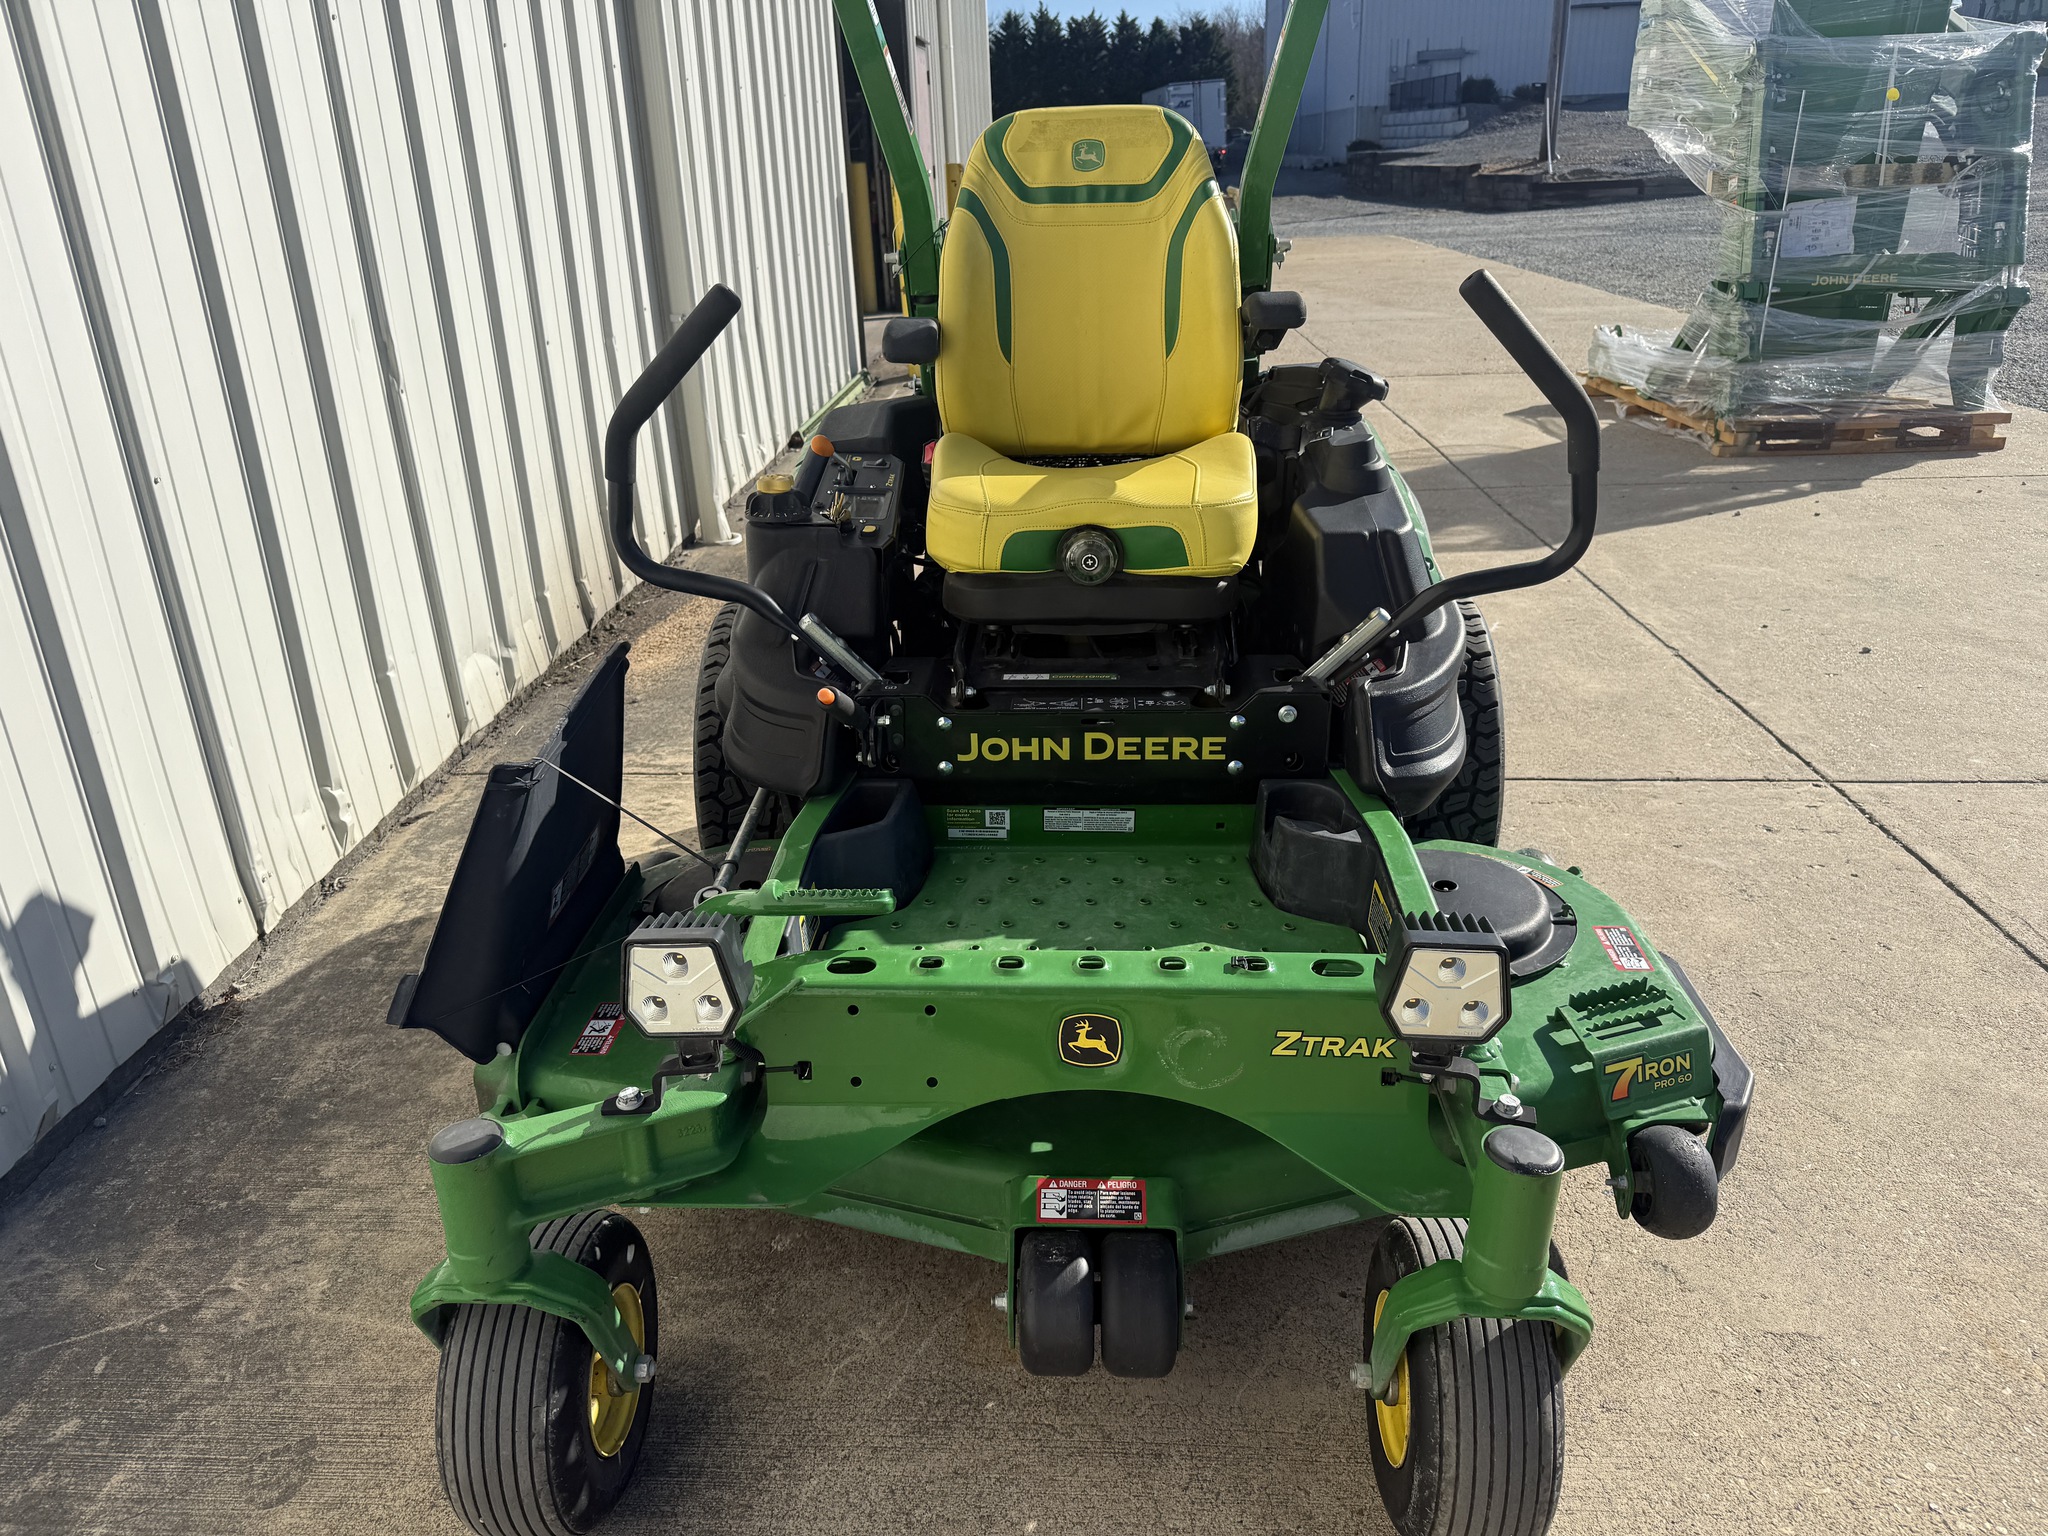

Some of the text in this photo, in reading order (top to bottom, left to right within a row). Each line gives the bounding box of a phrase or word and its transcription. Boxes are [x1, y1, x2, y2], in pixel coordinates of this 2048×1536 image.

[1811, 274, 1850, 286] JOHN
[957, 731, 1227, 762] JOHN DEERE
[1271, 1030, 1398, 1058] ZTRAK
[1654, 1073, 1693, 1091] PRO 60
[1059, 1180, 1087, 1188] DANGER
[1107, 1181, 1137, 1189] PELIGRO
